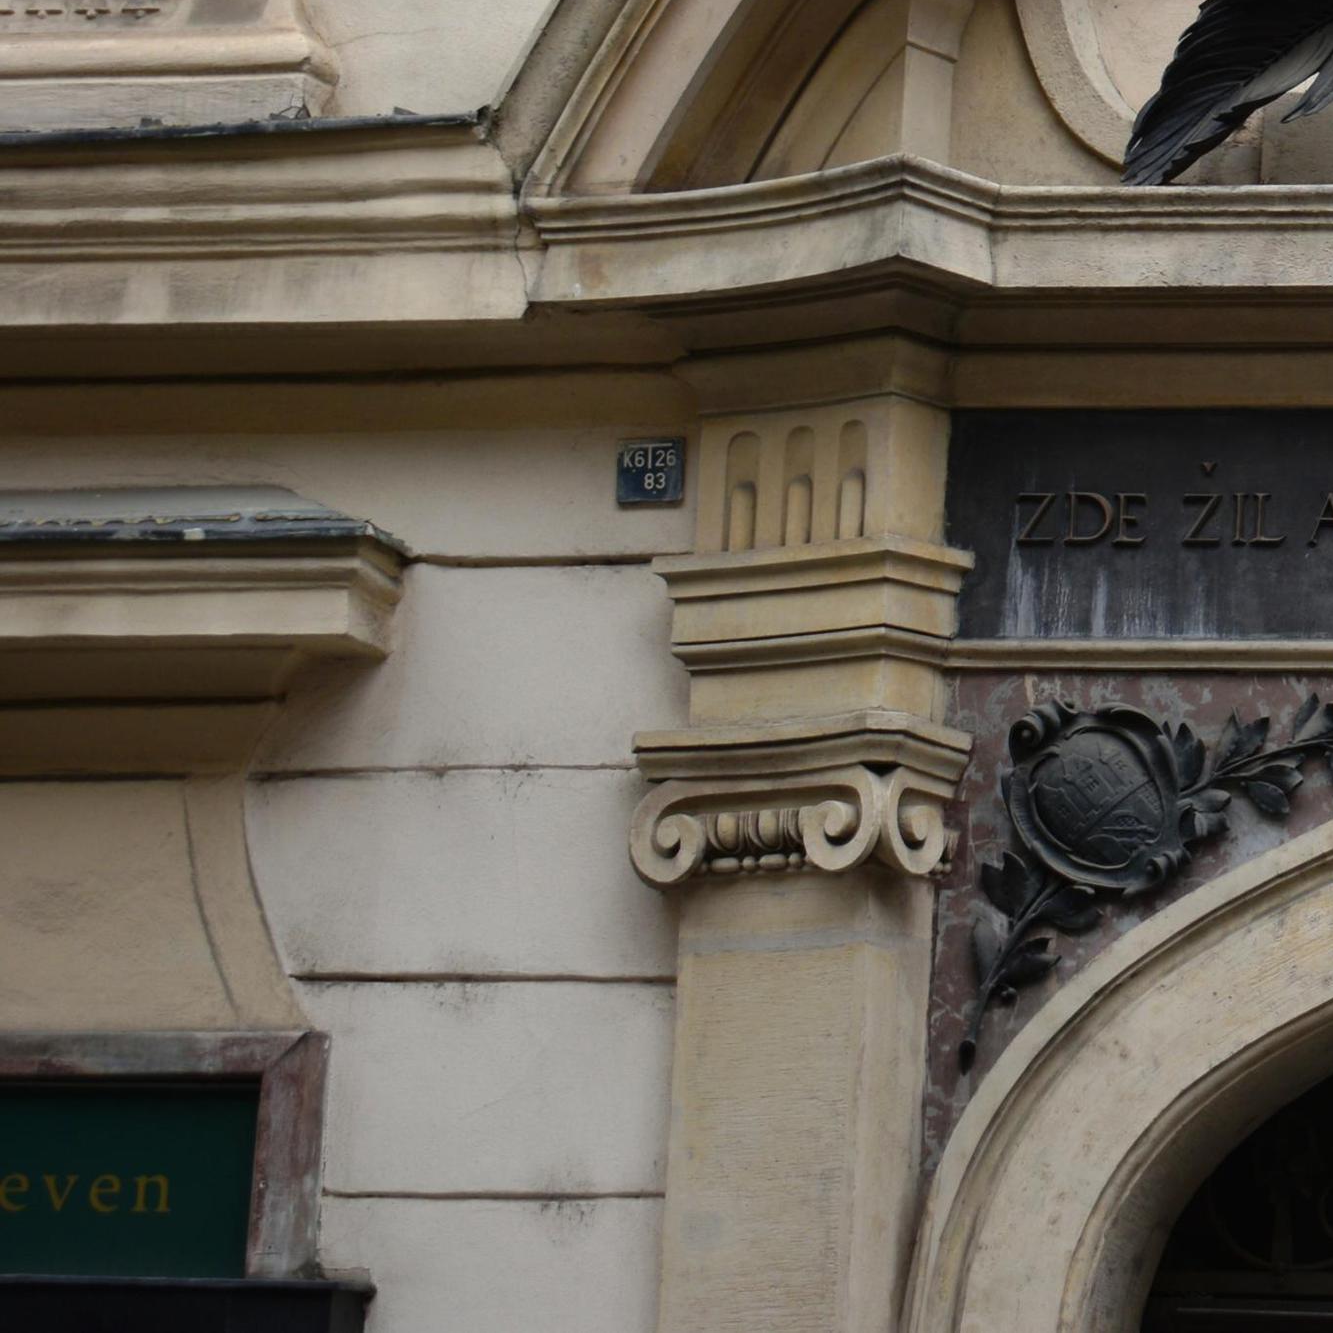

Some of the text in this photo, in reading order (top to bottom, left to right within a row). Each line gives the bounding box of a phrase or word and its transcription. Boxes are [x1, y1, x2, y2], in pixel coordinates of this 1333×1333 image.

[623, 449, 676, 467] K6 26
[644, 472, 666, 490] 83
[1014, 490, 1148, 549] ZDE
[1180, 460, 1287, 549] ŽIL
[0, 1171, 172, 1214] even
